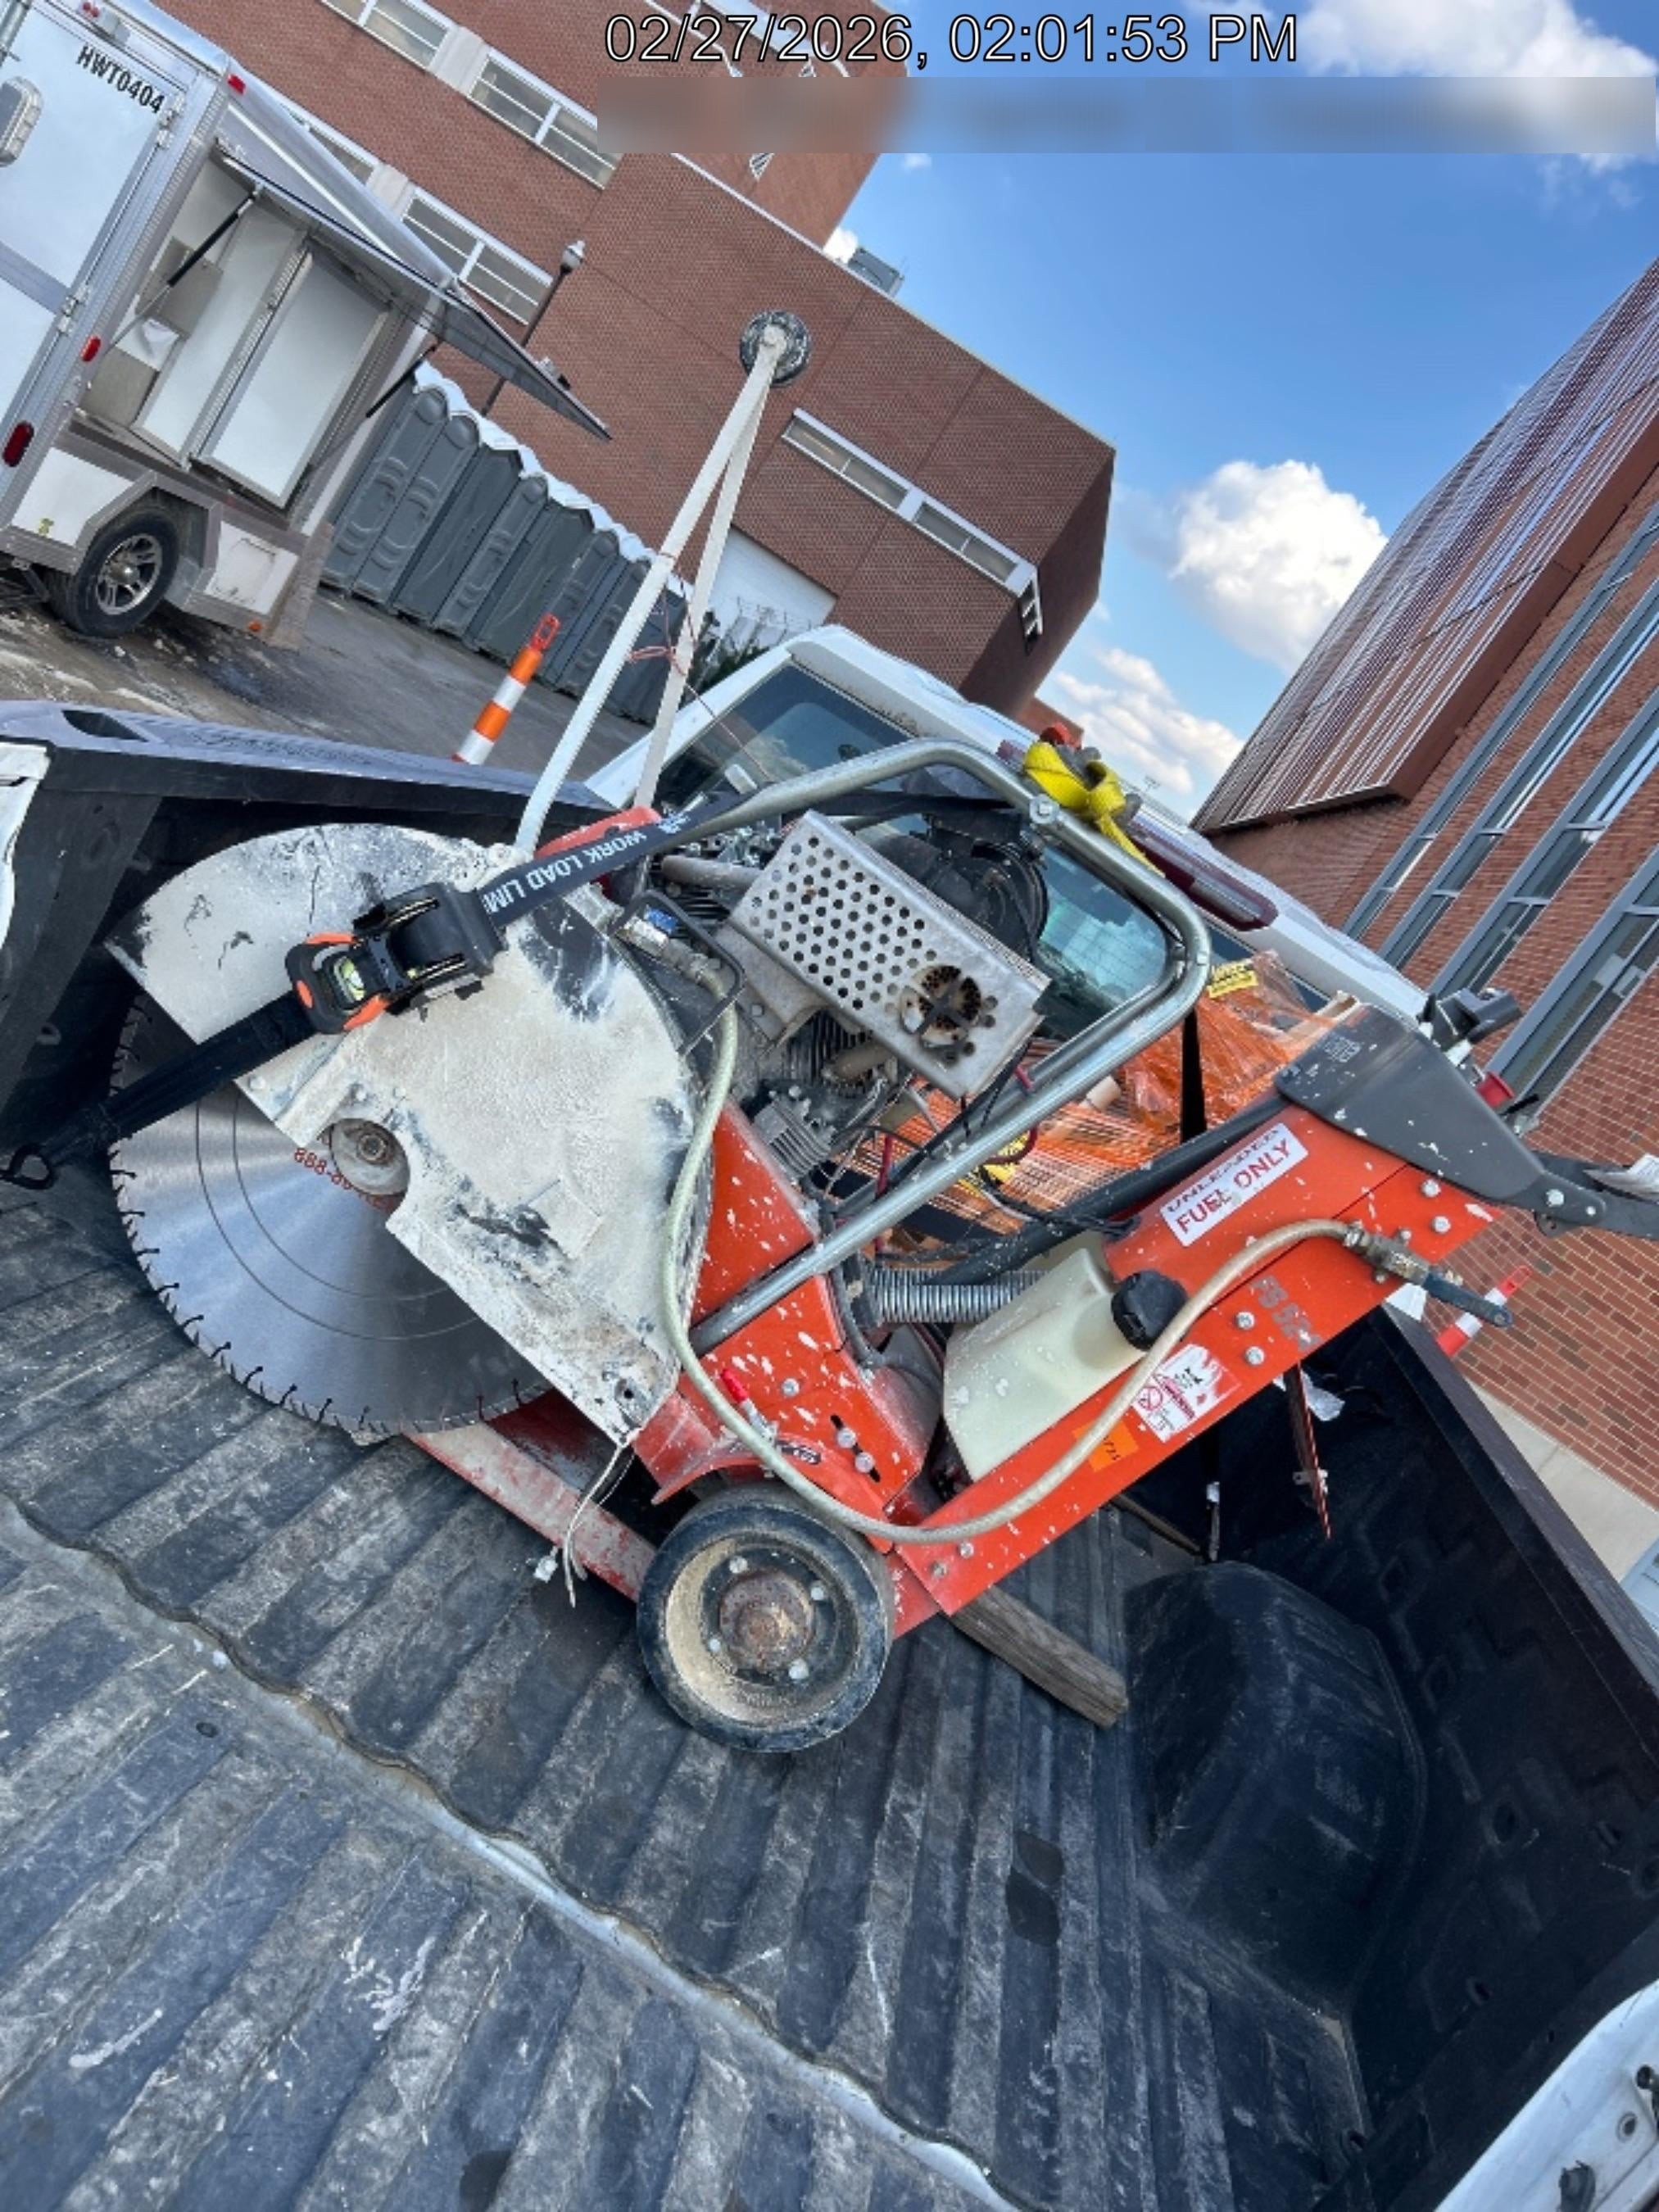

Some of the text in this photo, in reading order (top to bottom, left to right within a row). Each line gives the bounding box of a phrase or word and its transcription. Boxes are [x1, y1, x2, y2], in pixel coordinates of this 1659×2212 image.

[76, 46, 165, 114] HWT0404
[525, 854, 584, 891] LOAD
[582, 829, 647, 864] WORK
[1175, 1139, 1290, 1234] FUEL ONLY
